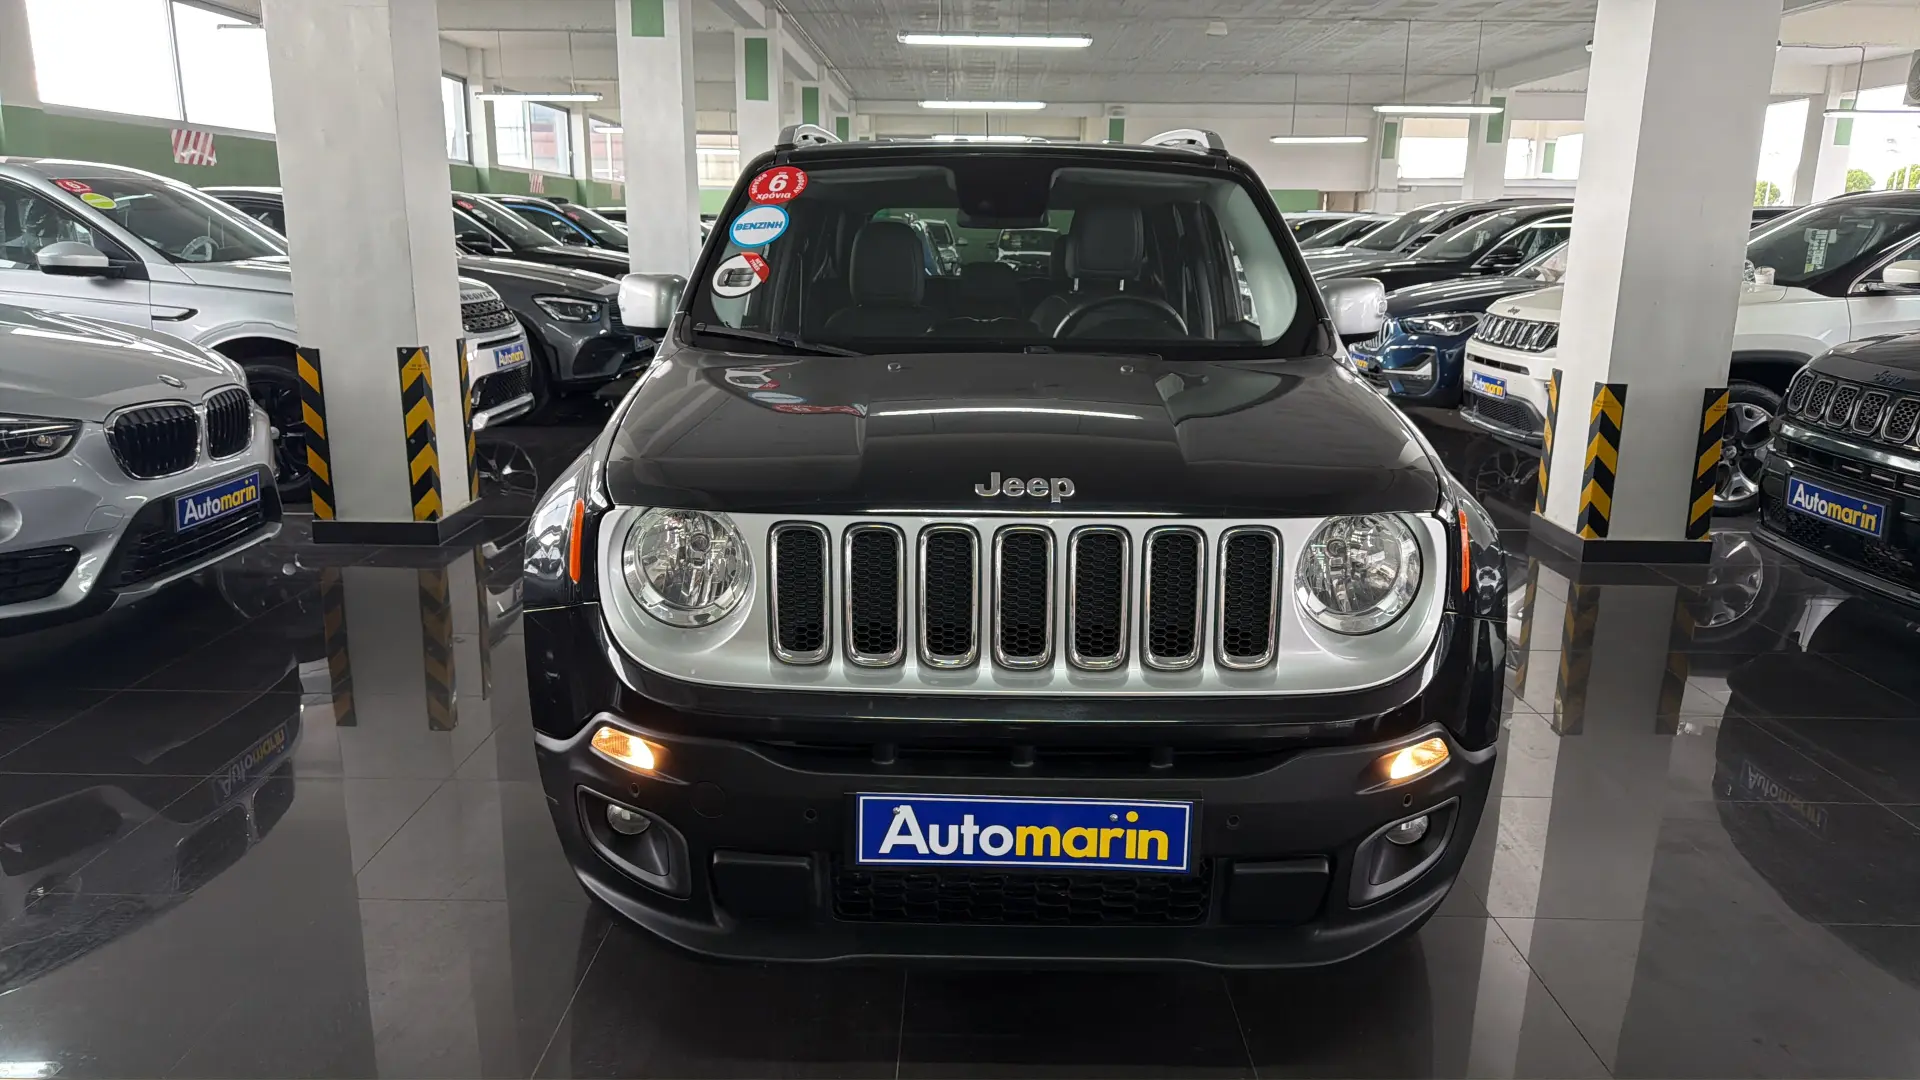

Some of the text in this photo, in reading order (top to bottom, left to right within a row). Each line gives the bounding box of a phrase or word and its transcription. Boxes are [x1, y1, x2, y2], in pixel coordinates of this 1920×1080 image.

[756, 191, 791, 200] χρόνια
[769, 174, 788, 191] 6
[1472, 373, 1503, 396] Automarin
[184, 479, 256, 525] Automarin
[975, 472, 1075, 503] Jeep
[1792, 483, 1877, 531] Automarin
[878, 805, 1168, 860] Automarin
